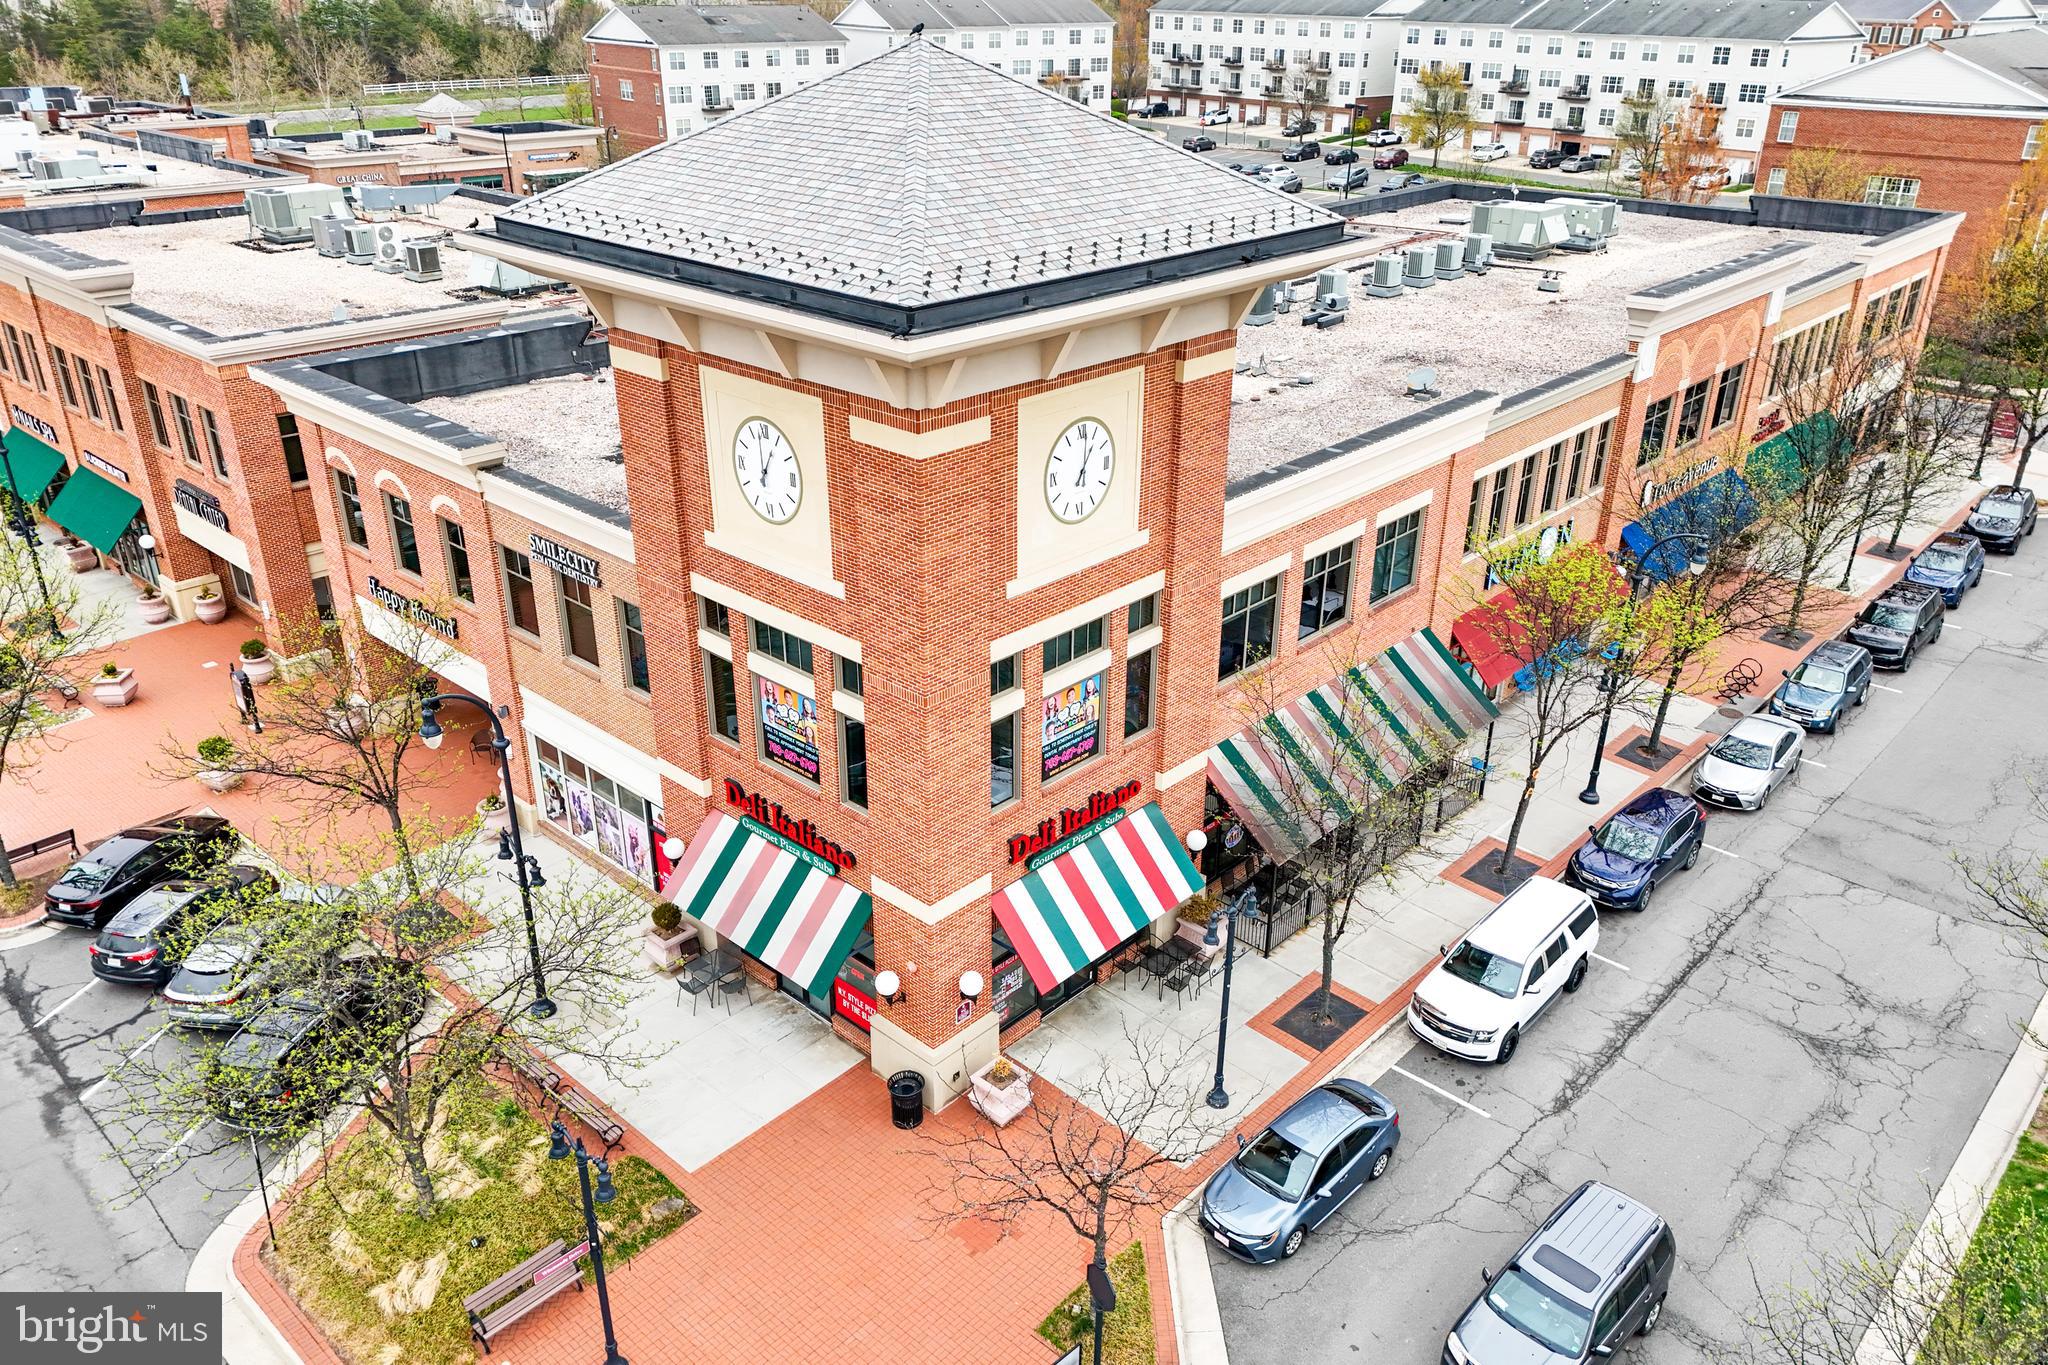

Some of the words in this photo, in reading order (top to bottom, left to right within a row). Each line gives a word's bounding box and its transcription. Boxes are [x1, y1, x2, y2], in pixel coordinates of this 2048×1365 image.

[337, 175, 358, 183] GREAT
[361, 172, 384, 181] CHINA
[528, 533, 598, 578] SMILECITY
[562, 564, 600, 588] DENTISTRY
[367, 576, 407, 619] Happy
[410, 599, 457, 640] Hound
[724, 778, 769, 824] Deli
[770, 801, 856, 870] Italiano
[741, 817, 779, 845] Gourmet
[779, 838, 801, 857] Pizza
[801, 849, 812, 863] &
[812, 856, 834, 876] Subs
[1008, 817, 1057, 865] Deli
[1060, 780, 1141, 836] Italiano
[1030, 841, 1071, 870] Gourmet
[1072, 828, 1094, 847] Pizza
[1094, 822, 1104, 834] &
[1104, 810, 1125, 828] Subs
[847, 992, 865, 1010] STYLE
